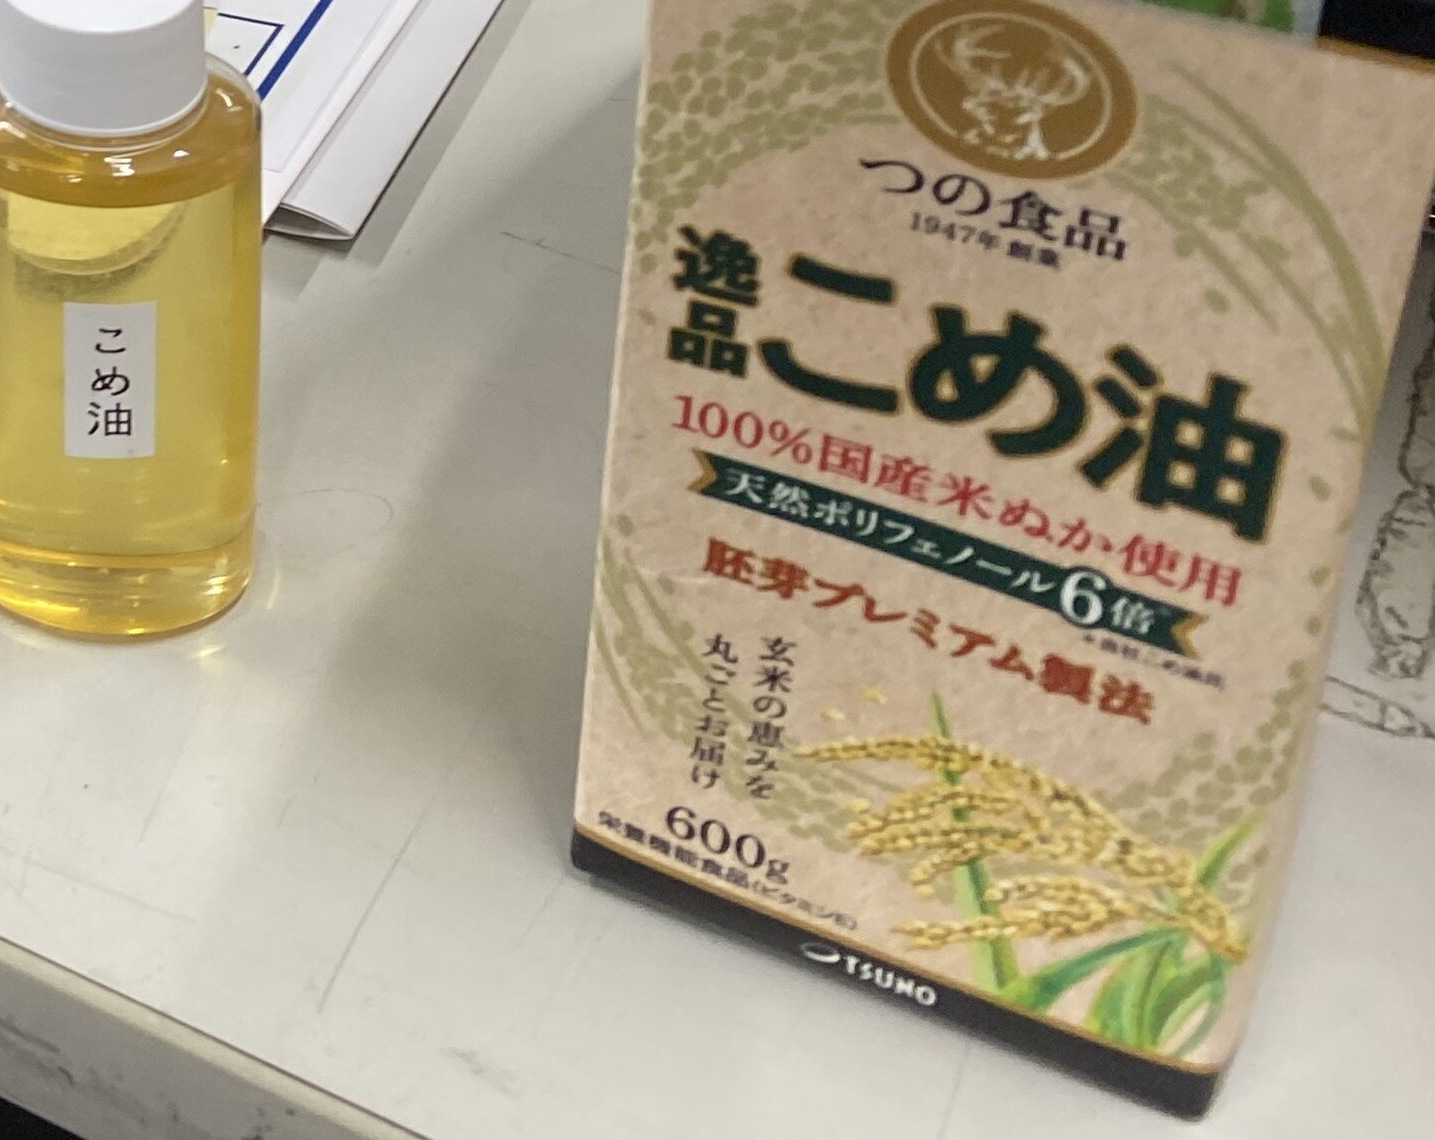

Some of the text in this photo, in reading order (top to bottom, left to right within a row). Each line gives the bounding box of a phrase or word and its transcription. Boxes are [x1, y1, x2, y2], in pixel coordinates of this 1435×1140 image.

[859, 159, 1127, 262] つの食品
[670, 223, 763, 379] 逸品
[87, 326, 133, 437] こめ油
[756, 252, 1290, 544] こめ油
[671, 394, 1243, 609] 100%国産米ぬか使用
[701, 536, 1157, 724] 胚芽プレミアム製法
[689, 632, 740, 792] 丸ごとお届け
[746, 634, 799, 800] 玄米の恵みを
[664, 805, 791, 886] 600g
